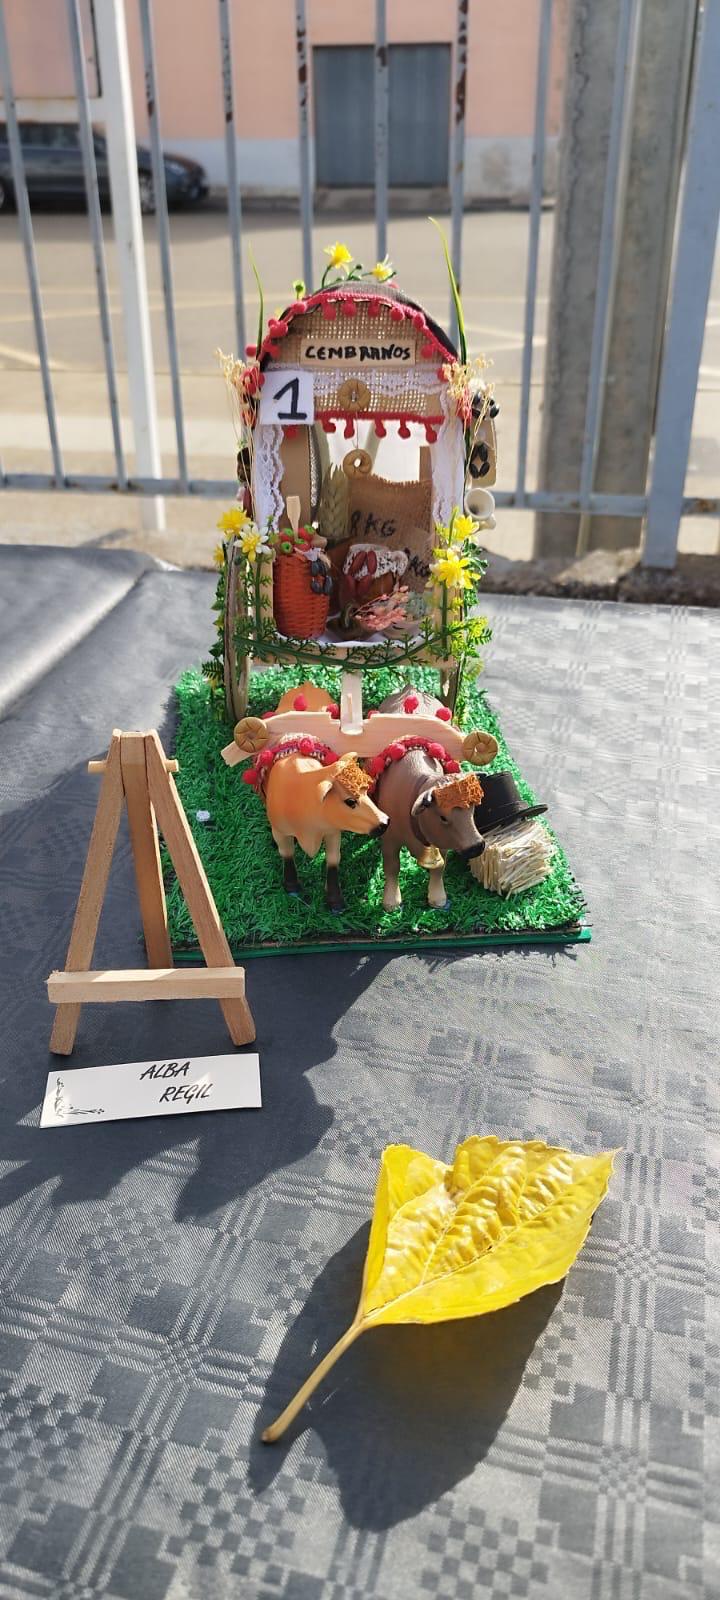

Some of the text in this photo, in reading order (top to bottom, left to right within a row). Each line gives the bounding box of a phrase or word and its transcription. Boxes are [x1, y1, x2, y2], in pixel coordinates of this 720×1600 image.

[305, 343, 411, 361] CEMBRANOS
[272, 376, 308, 420] 1
[139, 1061, 191, 1080] ALBA
[159, 1083, 213, 1104] REGIL
